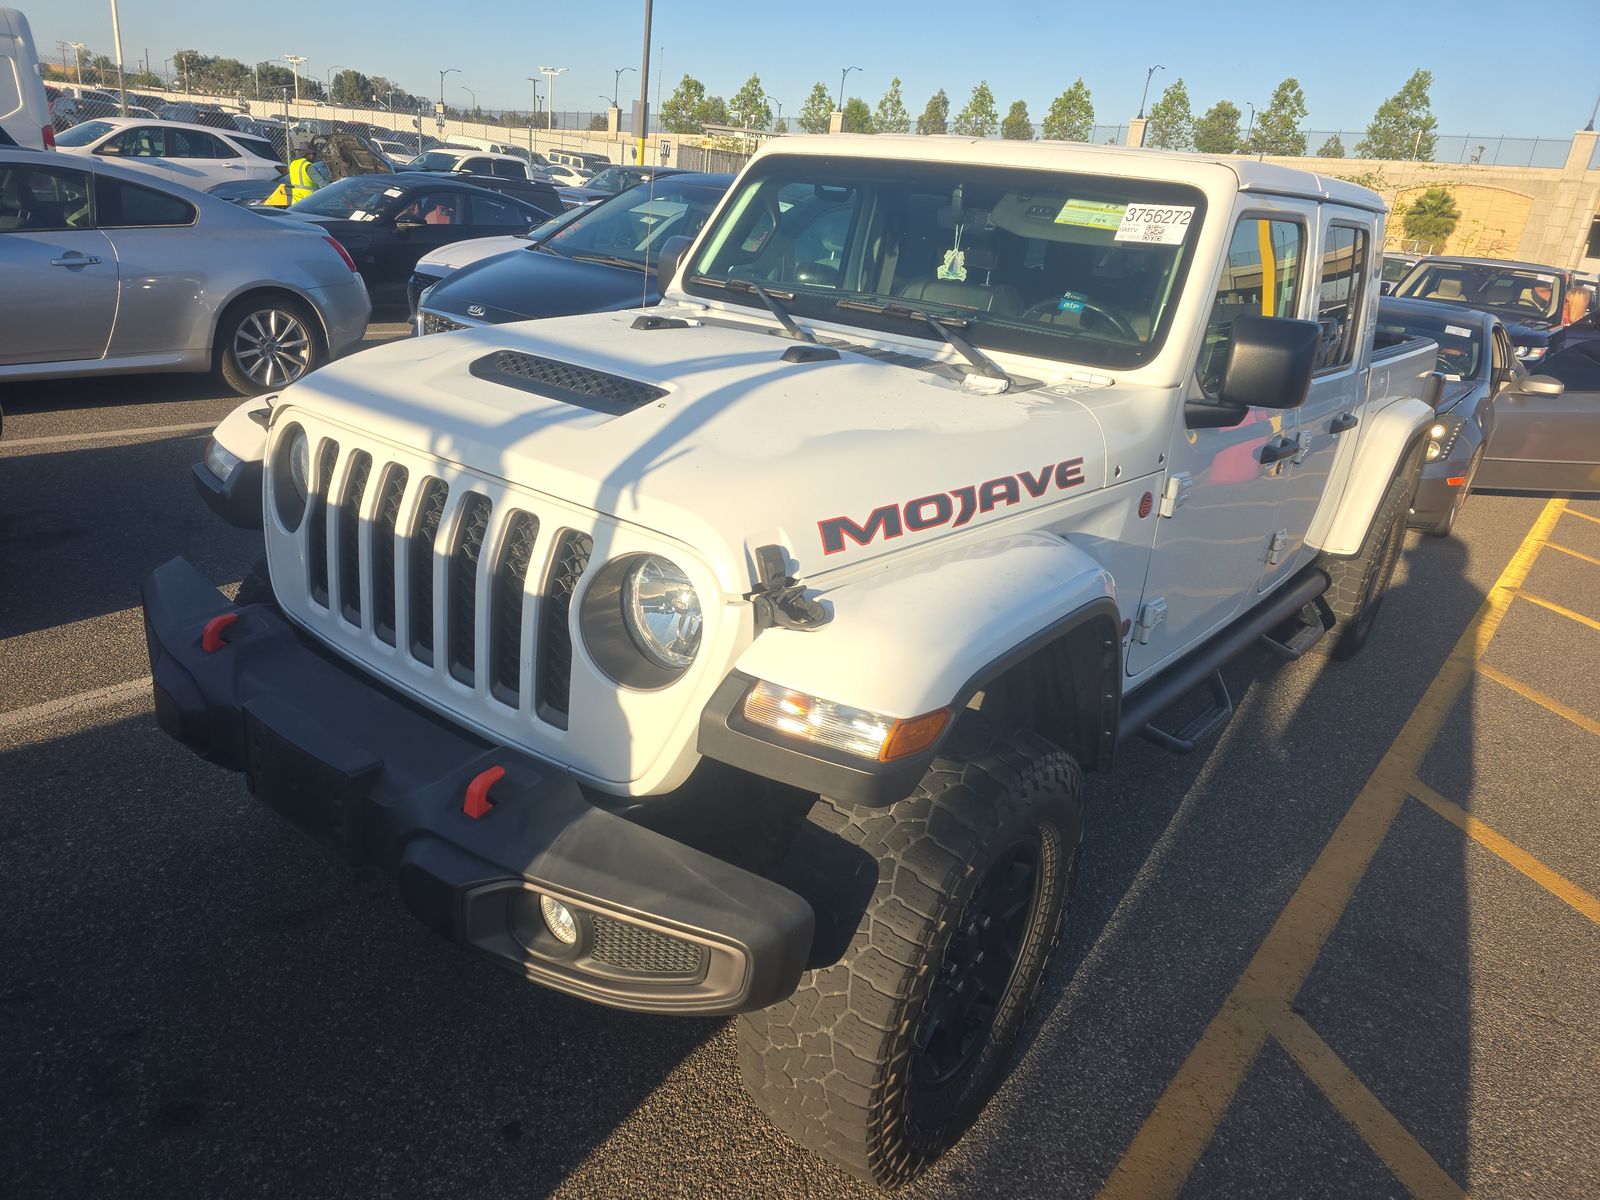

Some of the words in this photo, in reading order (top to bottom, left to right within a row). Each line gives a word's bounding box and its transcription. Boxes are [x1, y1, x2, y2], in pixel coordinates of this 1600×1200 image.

[1125, 207, 1193, 225] 3756272
[468, 305, 483, 315] KIA
[817, 456, 1086, 556] MOJAVE
